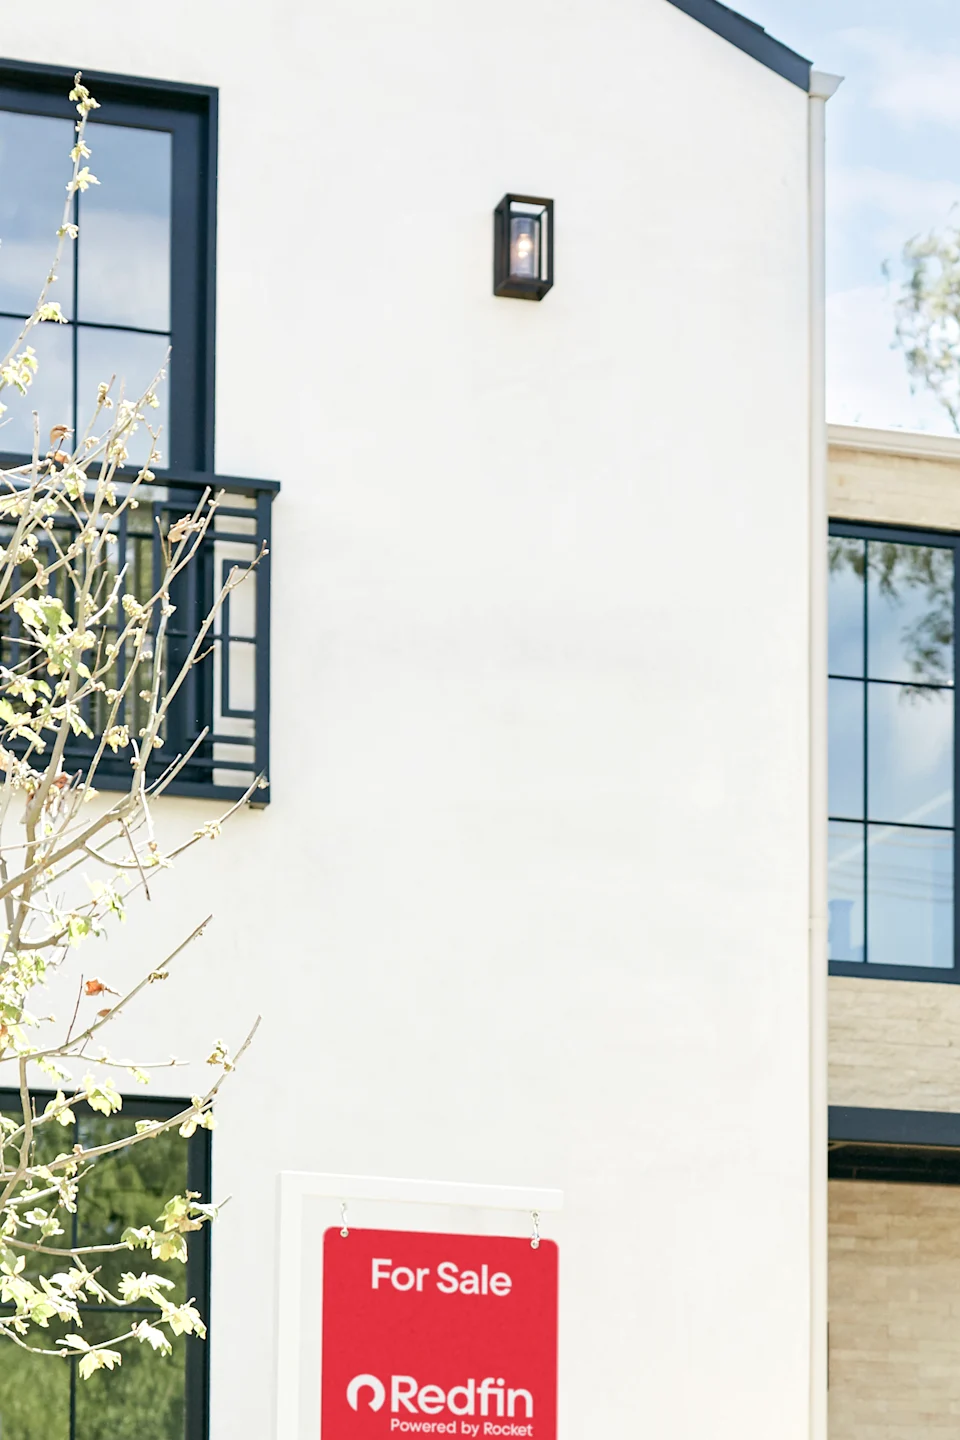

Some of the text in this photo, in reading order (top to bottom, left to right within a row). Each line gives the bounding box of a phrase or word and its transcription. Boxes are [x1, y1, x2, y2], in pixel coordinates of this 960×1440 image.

[371, 1258, 512, 1297] For Sale
[390, 1375, 534, 1418] Redfin
[390, 1418, 534, 1437] Powered by Rocket
